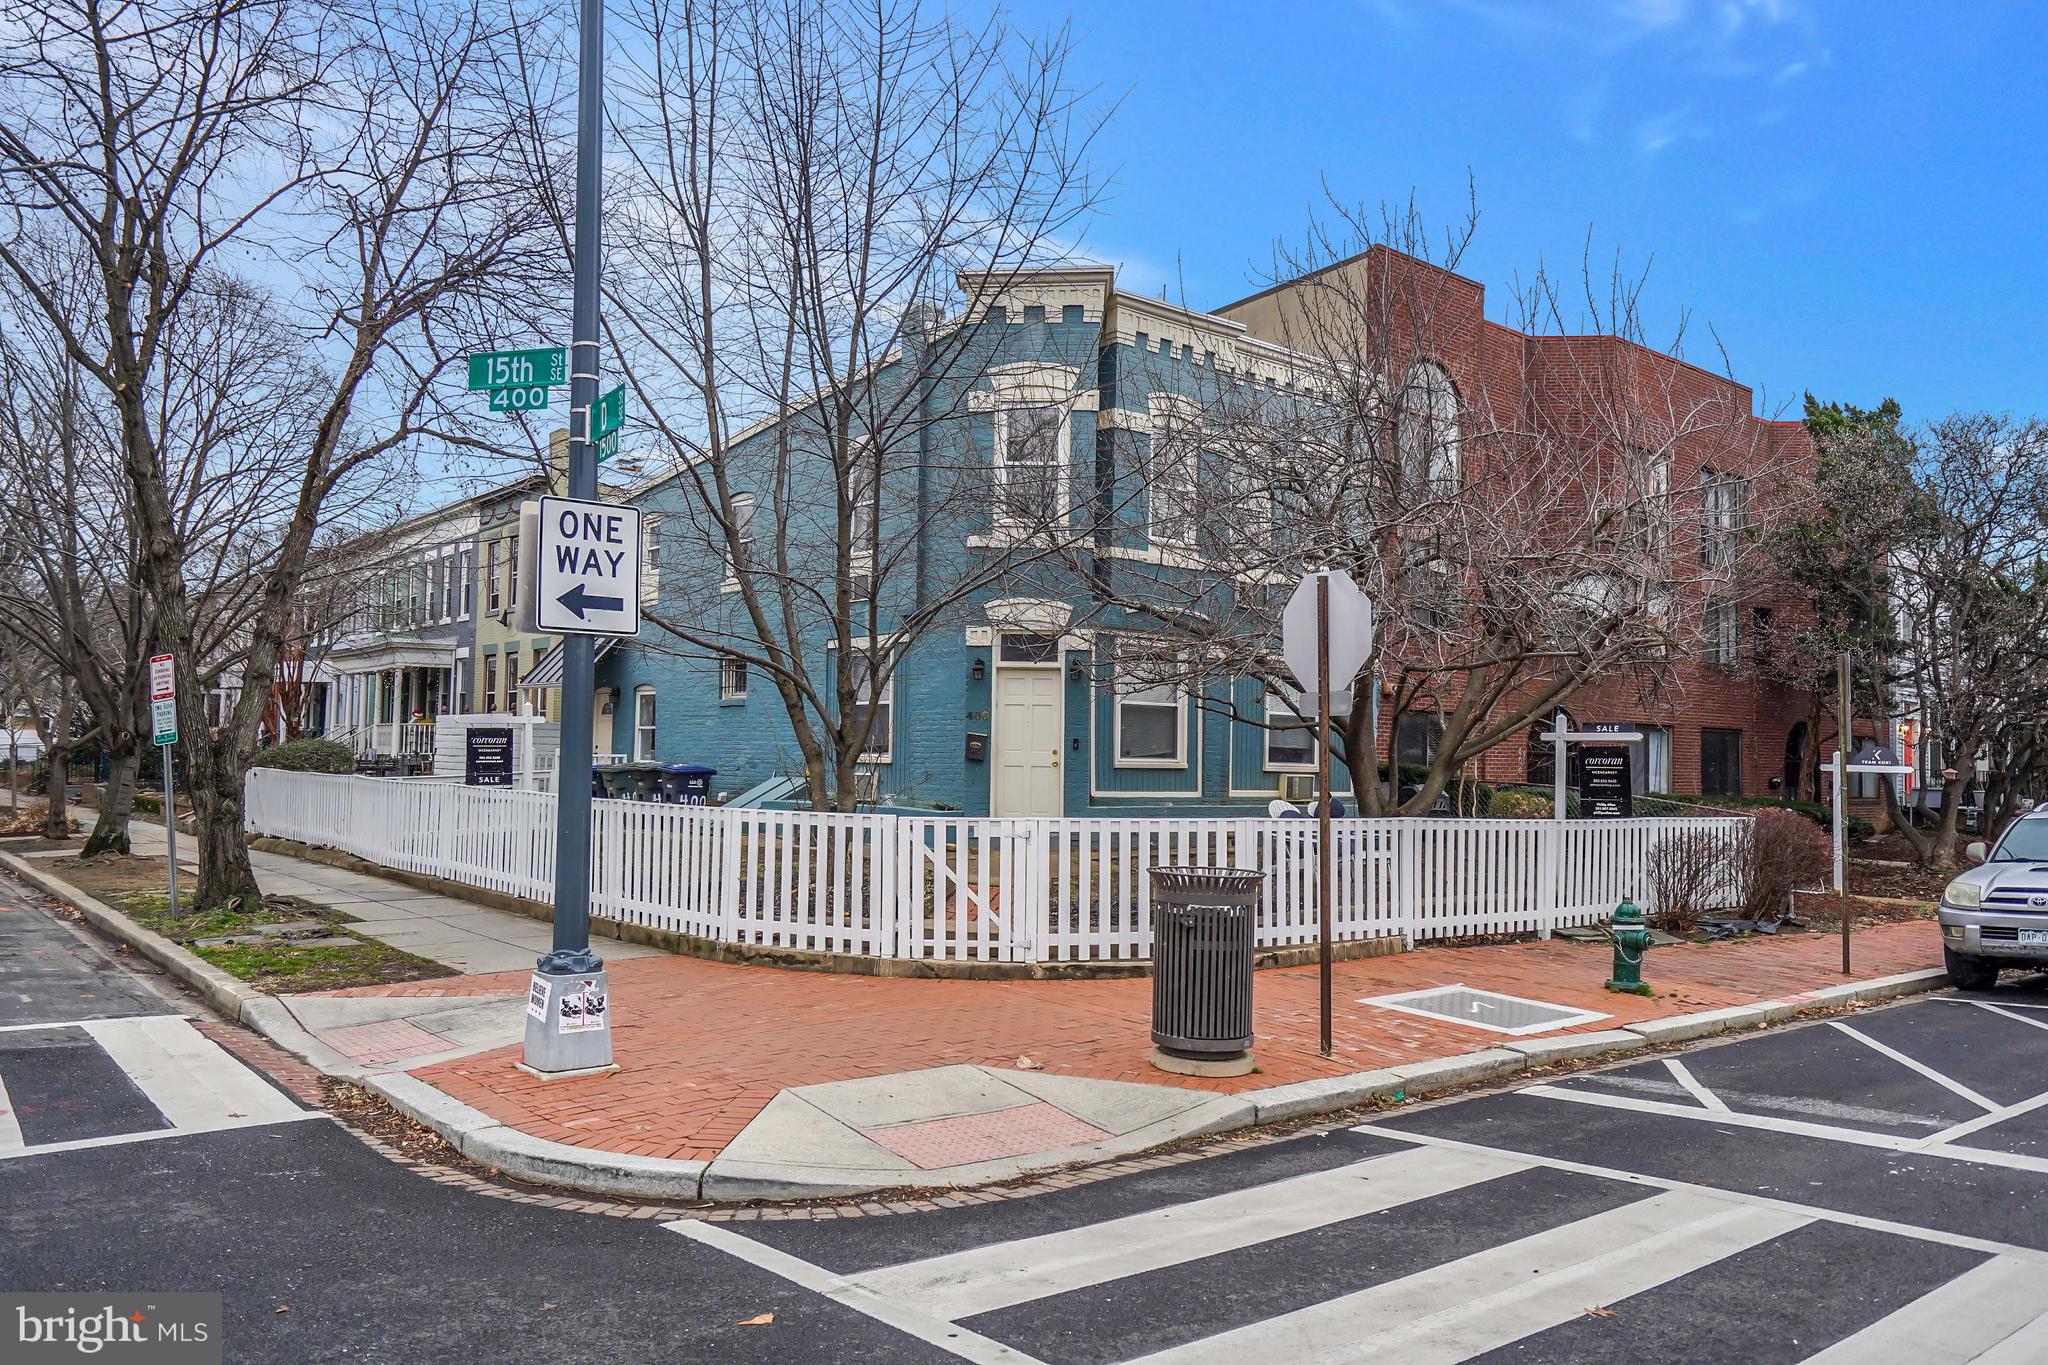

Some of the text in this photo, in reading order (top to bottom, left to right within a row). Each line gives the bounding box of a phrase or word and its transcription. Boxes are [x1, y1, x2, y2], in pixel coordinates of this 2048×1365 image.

[550, 353, 563, 366] St
[487, 355, 533, 385] 15th
[550, 367, 562, 381] SE
[493, 387, 544, 407] 400
[601, 401, 607, 431] D
[599, 431, 616, 459] 1500
[559, 510, 623, 544] ONE
[556, 545, 625, 578] WAY
[1585, 757, 1623, 765] corcoran
[2021, 932, 2048, 942] DAP-0
[531, 994, 545, 1010] WOMEN
